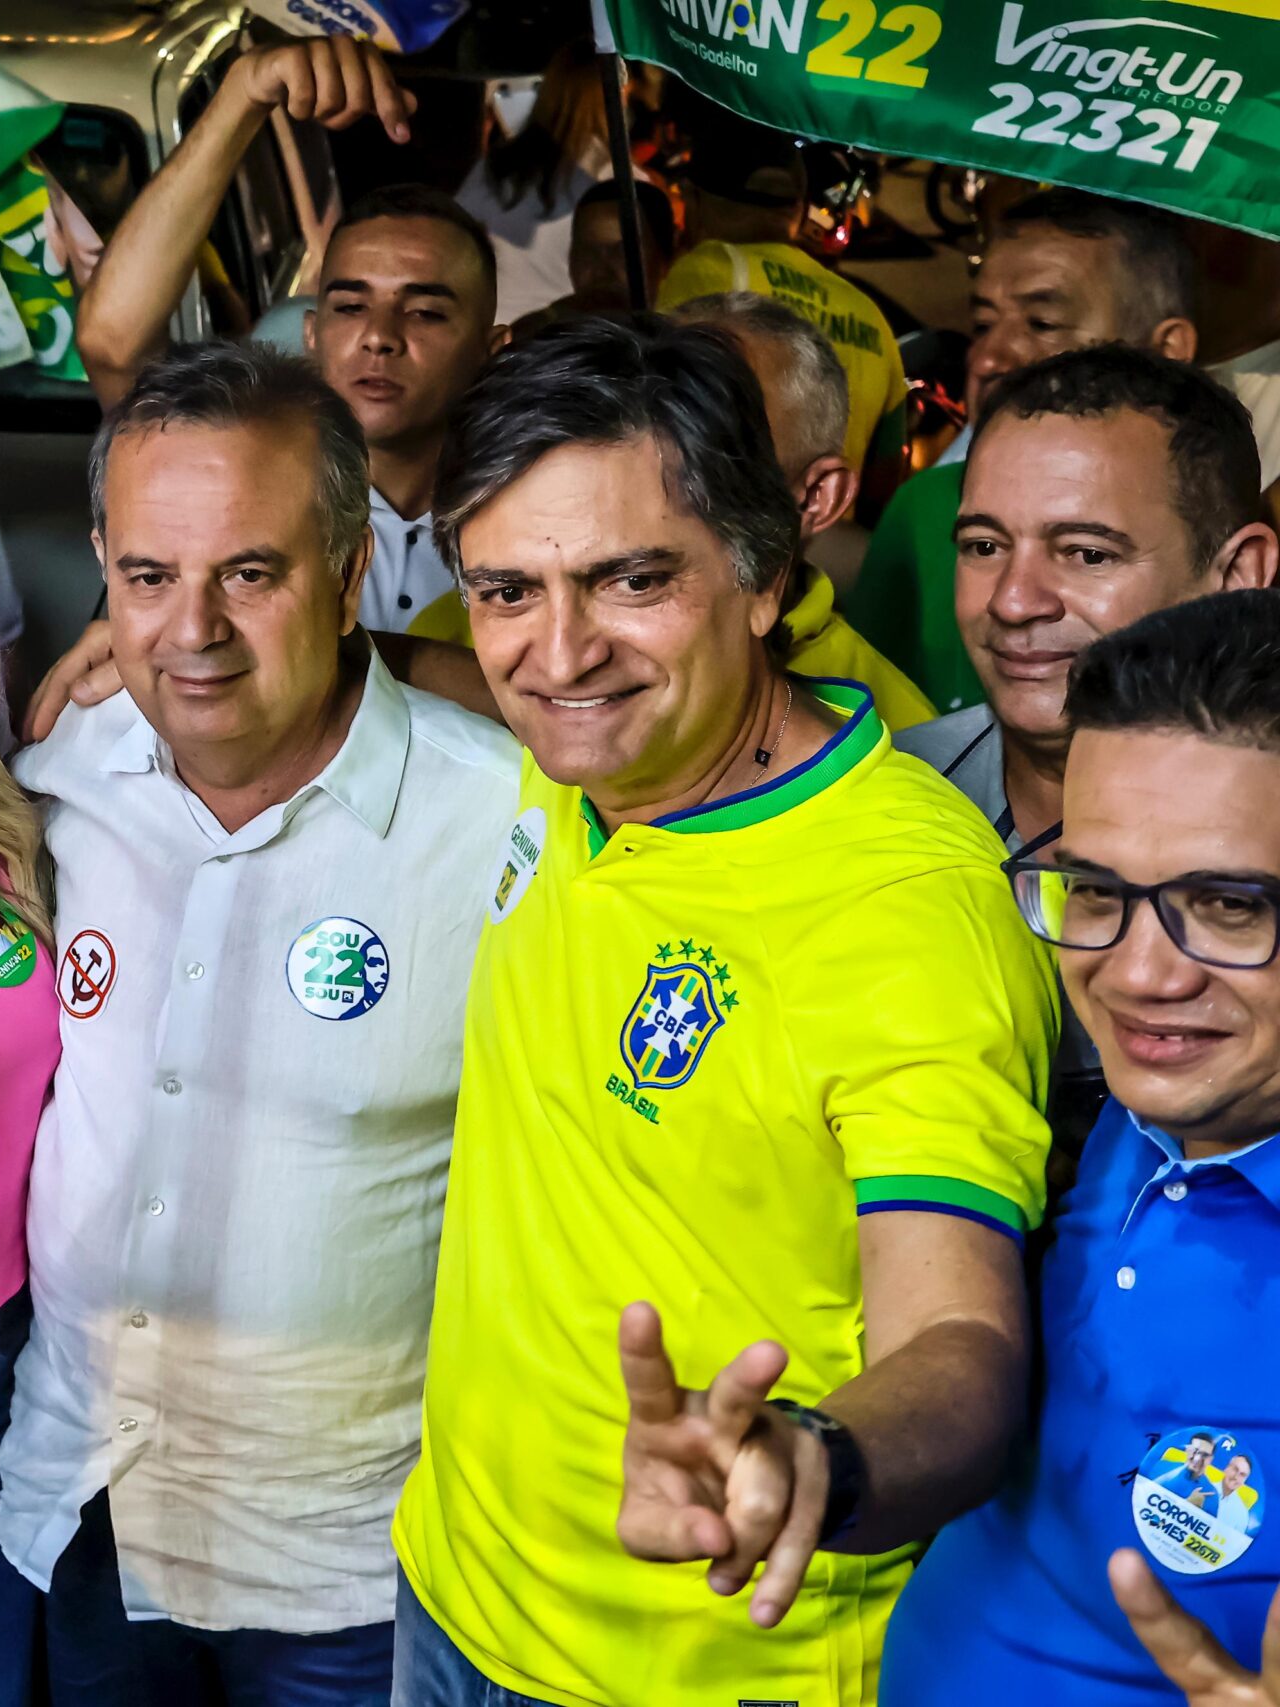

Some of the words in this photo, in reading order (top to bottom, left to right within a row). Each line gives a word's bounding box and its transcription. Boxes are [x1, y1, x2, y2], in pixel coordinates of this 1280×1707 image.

[699, 43, 758, 77] Gadêlha
[805, 0, 942, 89] 22
[1111, 86, 1228, 116] VEREADOR
[971, 82, 1221, 172] 22321
[510, 823, 540, 865] GENIVAN
[17, 944, 33, 961] 22
[316, 931, 360, 948] SOU
[304, 946, 366, 987] 22
[305, 986, 340, 1001] SOU
[654, 1009, 688, 1038] CBF
[606, 1073, 660, 1125] BRASIL
[1139, 1507, 1188, 1543] GOMES
[1147, 1493, 1212, 1541] CORONEL
